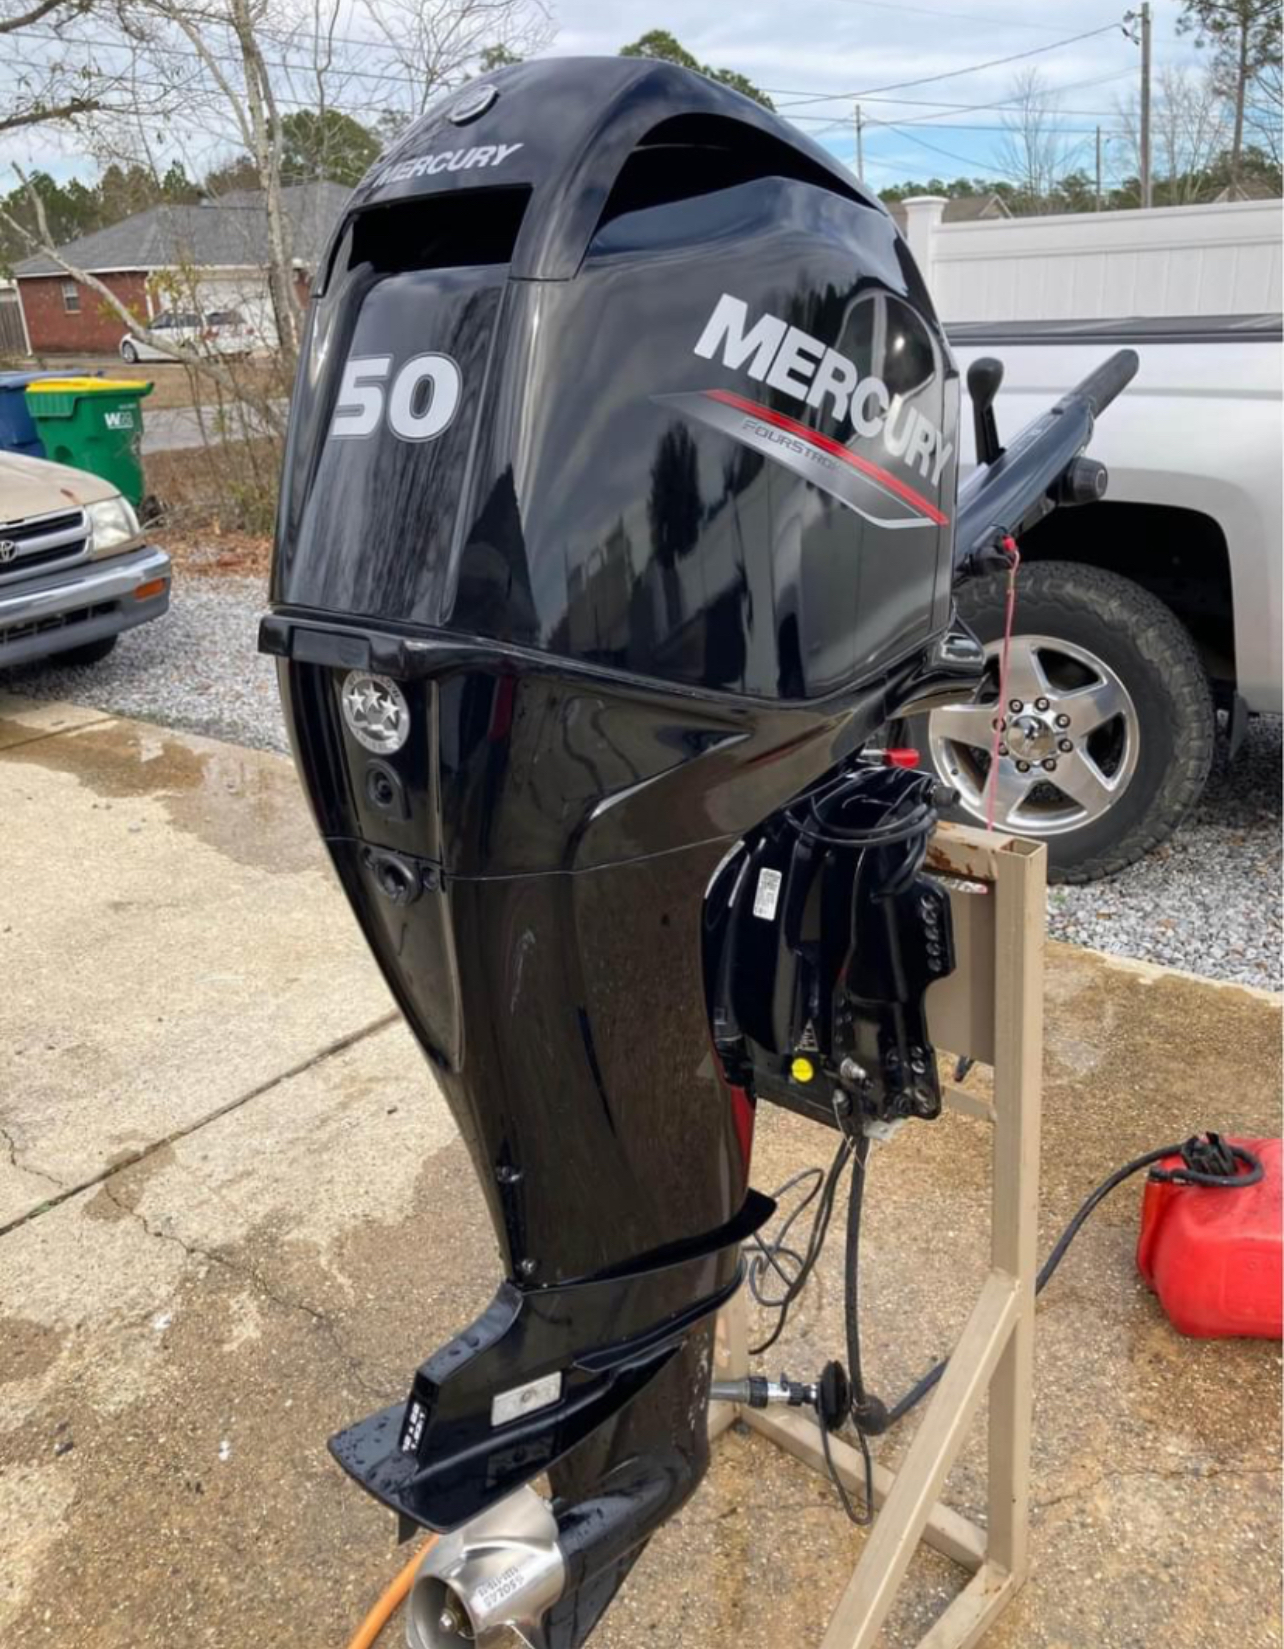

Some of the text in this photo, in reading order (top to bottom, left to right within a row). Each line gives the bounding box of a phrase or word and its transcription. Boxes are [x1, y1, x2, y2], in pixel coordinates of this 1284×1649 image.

[373, 143, 524, 187] MERCURY
[330, 351, 463, 443] 50
[694, 293, 954, 487] MERCURY
